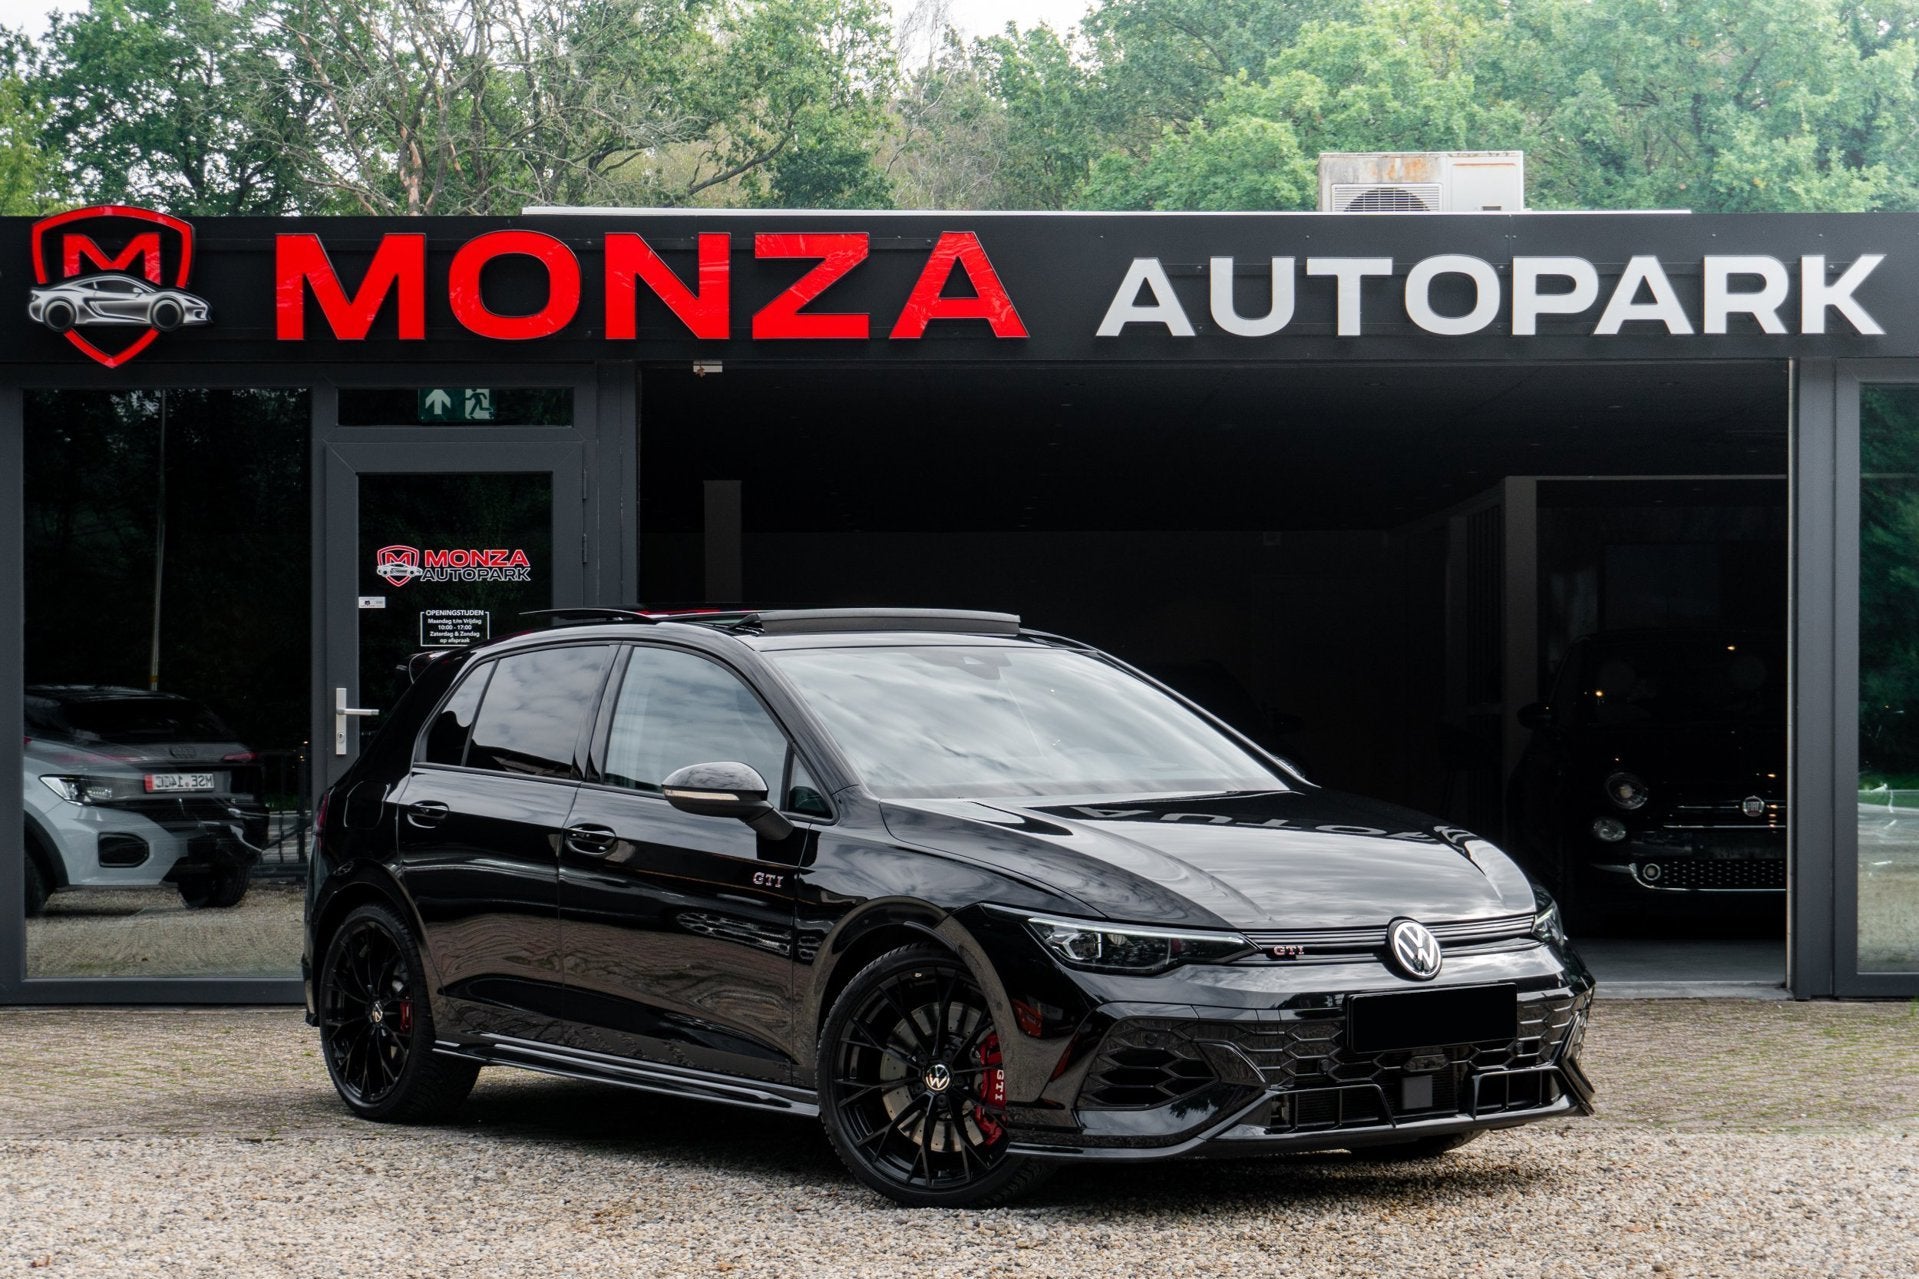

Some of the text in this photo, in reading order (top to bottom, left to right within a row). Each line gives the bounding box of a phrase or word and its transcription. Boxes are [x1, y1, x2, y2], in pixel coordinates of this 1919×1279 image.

[275, 229, 1887, 341] MONZA AUTOPARK
[425, 549, 529, 567] MONZA
[421, 567, 531, 581] AUTOPARK
[753, 871, 784, 888] GTI
[1273, 944, 1305, 956] GTI
[995, 1069, 1005, 1101] GTI
